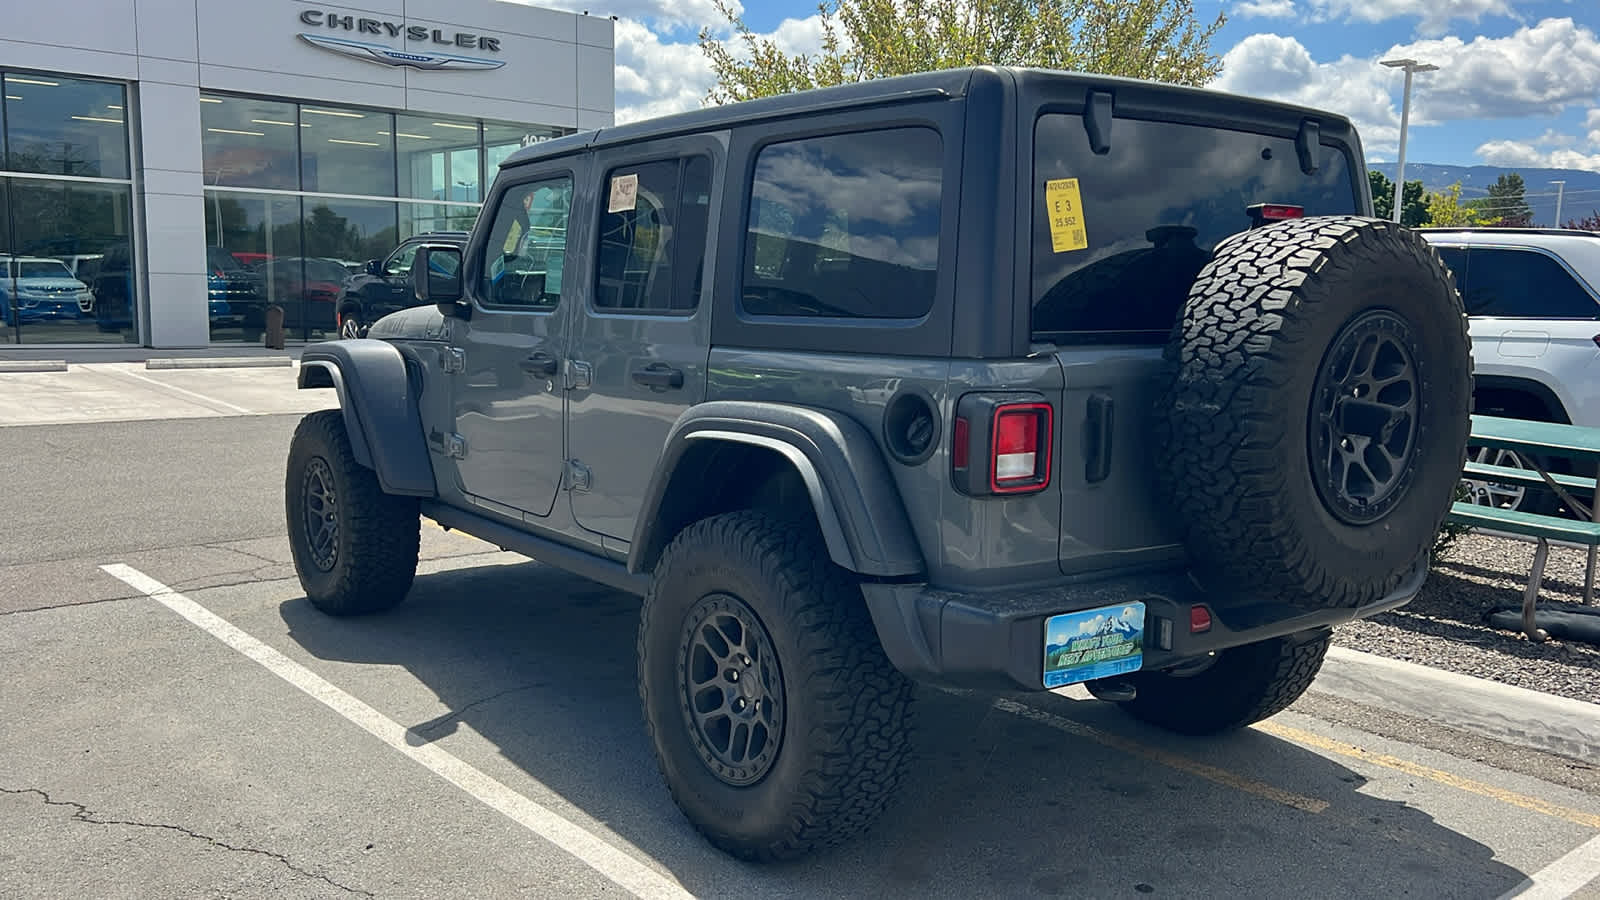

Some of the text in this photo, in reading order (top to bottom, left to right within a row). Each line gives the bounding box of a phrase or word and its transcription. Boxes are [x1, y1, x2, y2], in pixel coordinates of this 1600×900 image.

[300, 10, 501, 51] CHRYSLER
[1055, 200, 1072, 213] E 3
